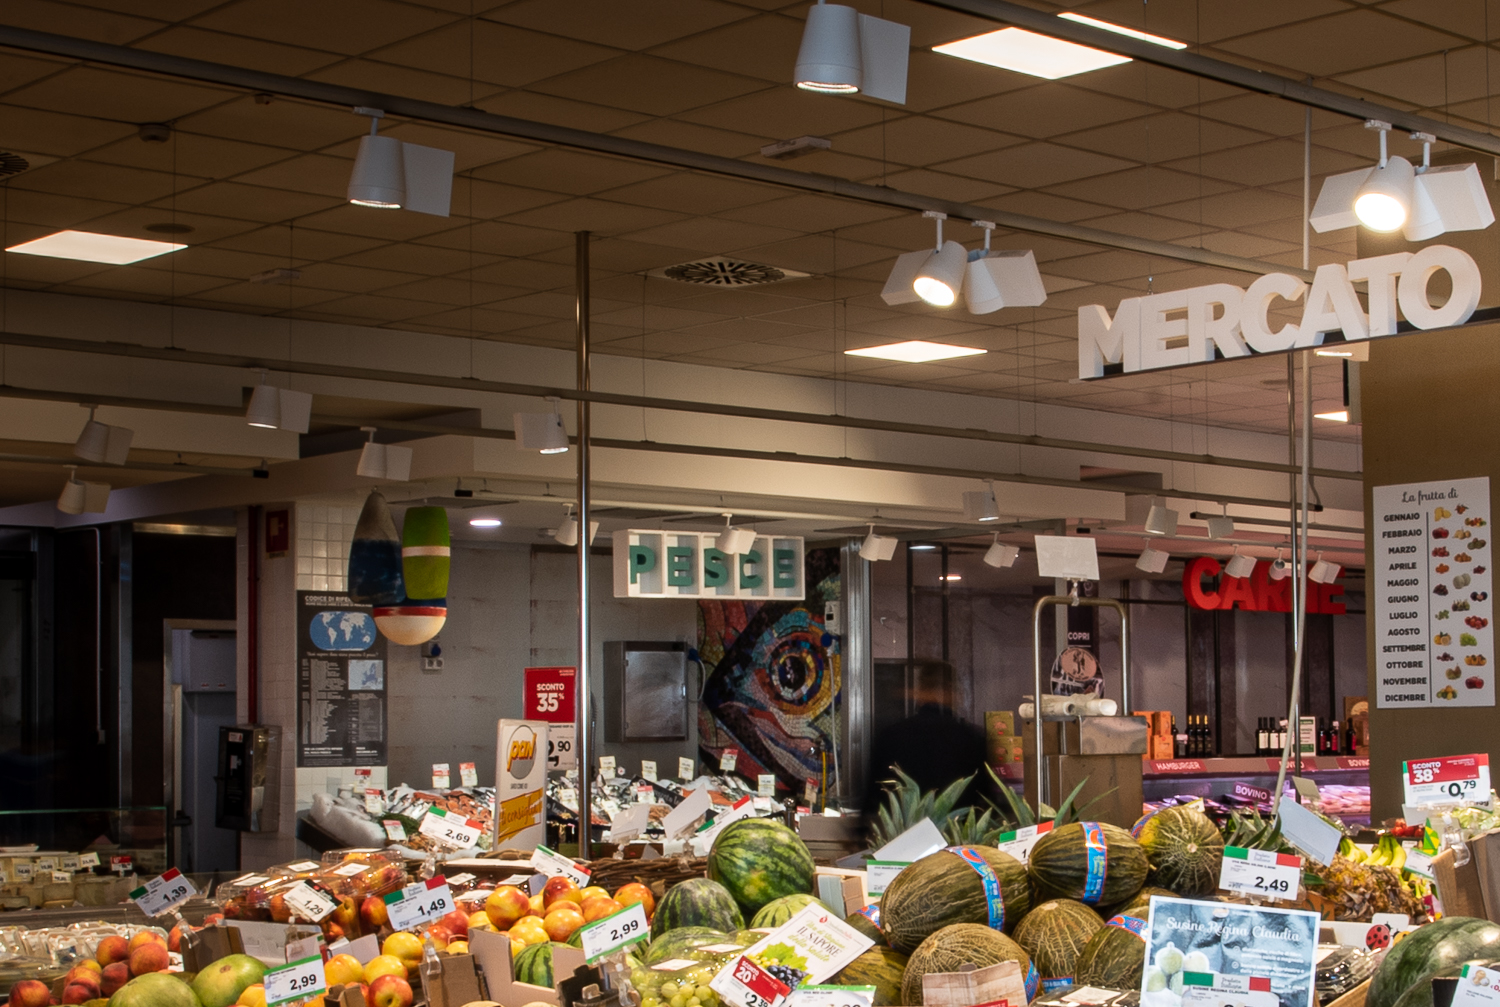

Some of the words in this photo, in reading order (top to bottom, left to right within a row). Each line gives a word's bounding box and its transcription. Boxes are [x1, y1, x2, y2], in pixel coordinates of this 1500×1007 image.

[1076, 247, 1482, 382] MERCATO
[1401, 490, 1416, 503] La
[1417, 489, 1447, 505] frutta
[1383, 512, 1421, 522] GENNAIO
[1382, 529, 1422, 539] FEBBRAIO
[1388, 546, 1417, 554] MARZO
[628, 543, 799, 590] PESCE
[1389, 562, 1417, 571] APRILE
[1387, 578, 1419, 587] MAGGIO
[1387, 595, 1419, 604] GIUGNO
[1389, 611, 1418, 620] LUGLIO
[1067, 631, 1091, 641] COPRI
[1387, 628, 1421, 637] AGOSTO
[1382, 644, 1426, 653] SETTEMBRE
[1386, 660, 1424, 669] OTTOBRE
[1383, 677, 1427, 686] NOVEMBRE
[536, 683, 565, 692] SCONTO
[1385, 693, 1426, 702] DICEMBRE
[1156, 761, 1201, 770] HAMBURGER
[1412, 761, 1442, 770] SCONTO
[1413, 766, 1441, 783] 38%
[1234, 783, 1268, 800] BOVINO
[445, 827, 471, 844] 2,69
[1255, 875, 1289, 893] 2,49
[163, 884, 188, 904] 1,39
[303, 899, 325, 915] 1,29
[417, 898, 446, 917] 1,49
[610, 919, 639, 941] 2,99
[1166, 916, 1205, 932] Susine
[1206, 920, 1249, 938] Regina
[1251, 924, 1301, 942] Claudia
[807, 931, 843, 957] SAPORE
[741, 960, 760, 976] SCONTO
[289, 973, 318, 992] 2,99
